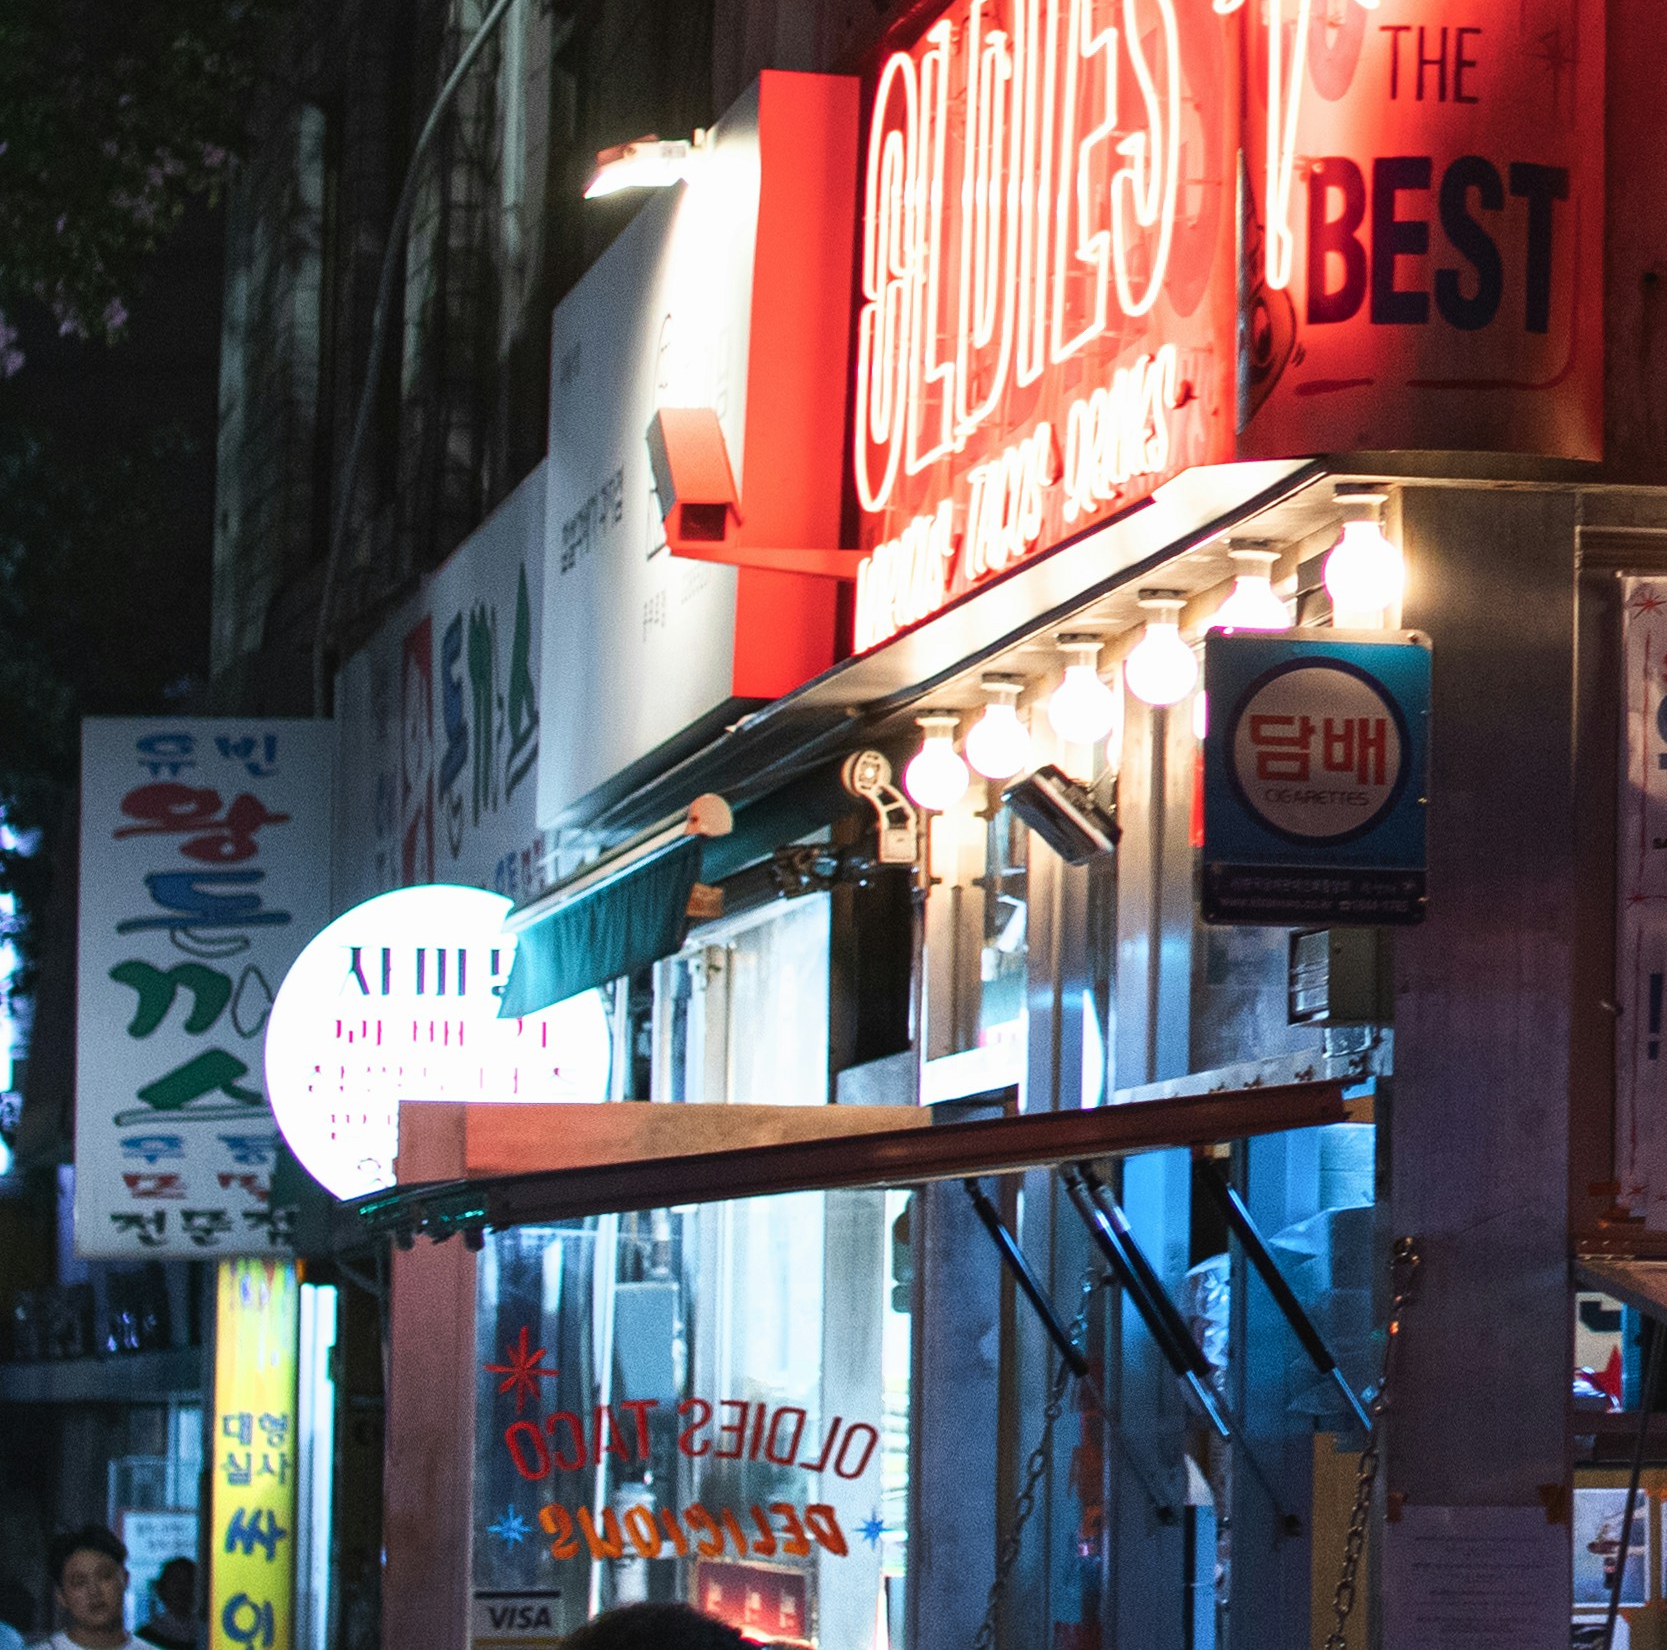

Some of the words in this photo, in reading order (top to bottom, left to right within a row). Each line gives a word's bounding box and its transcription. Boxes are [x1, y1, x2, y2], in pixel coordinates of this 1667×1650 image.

[1380, 24, 1481, 104] THE
[1305, 154, 1567, 334] BEST
[1250, 714, 1388, 786] 담배
[486, 1607, 554, 1630] VISA
